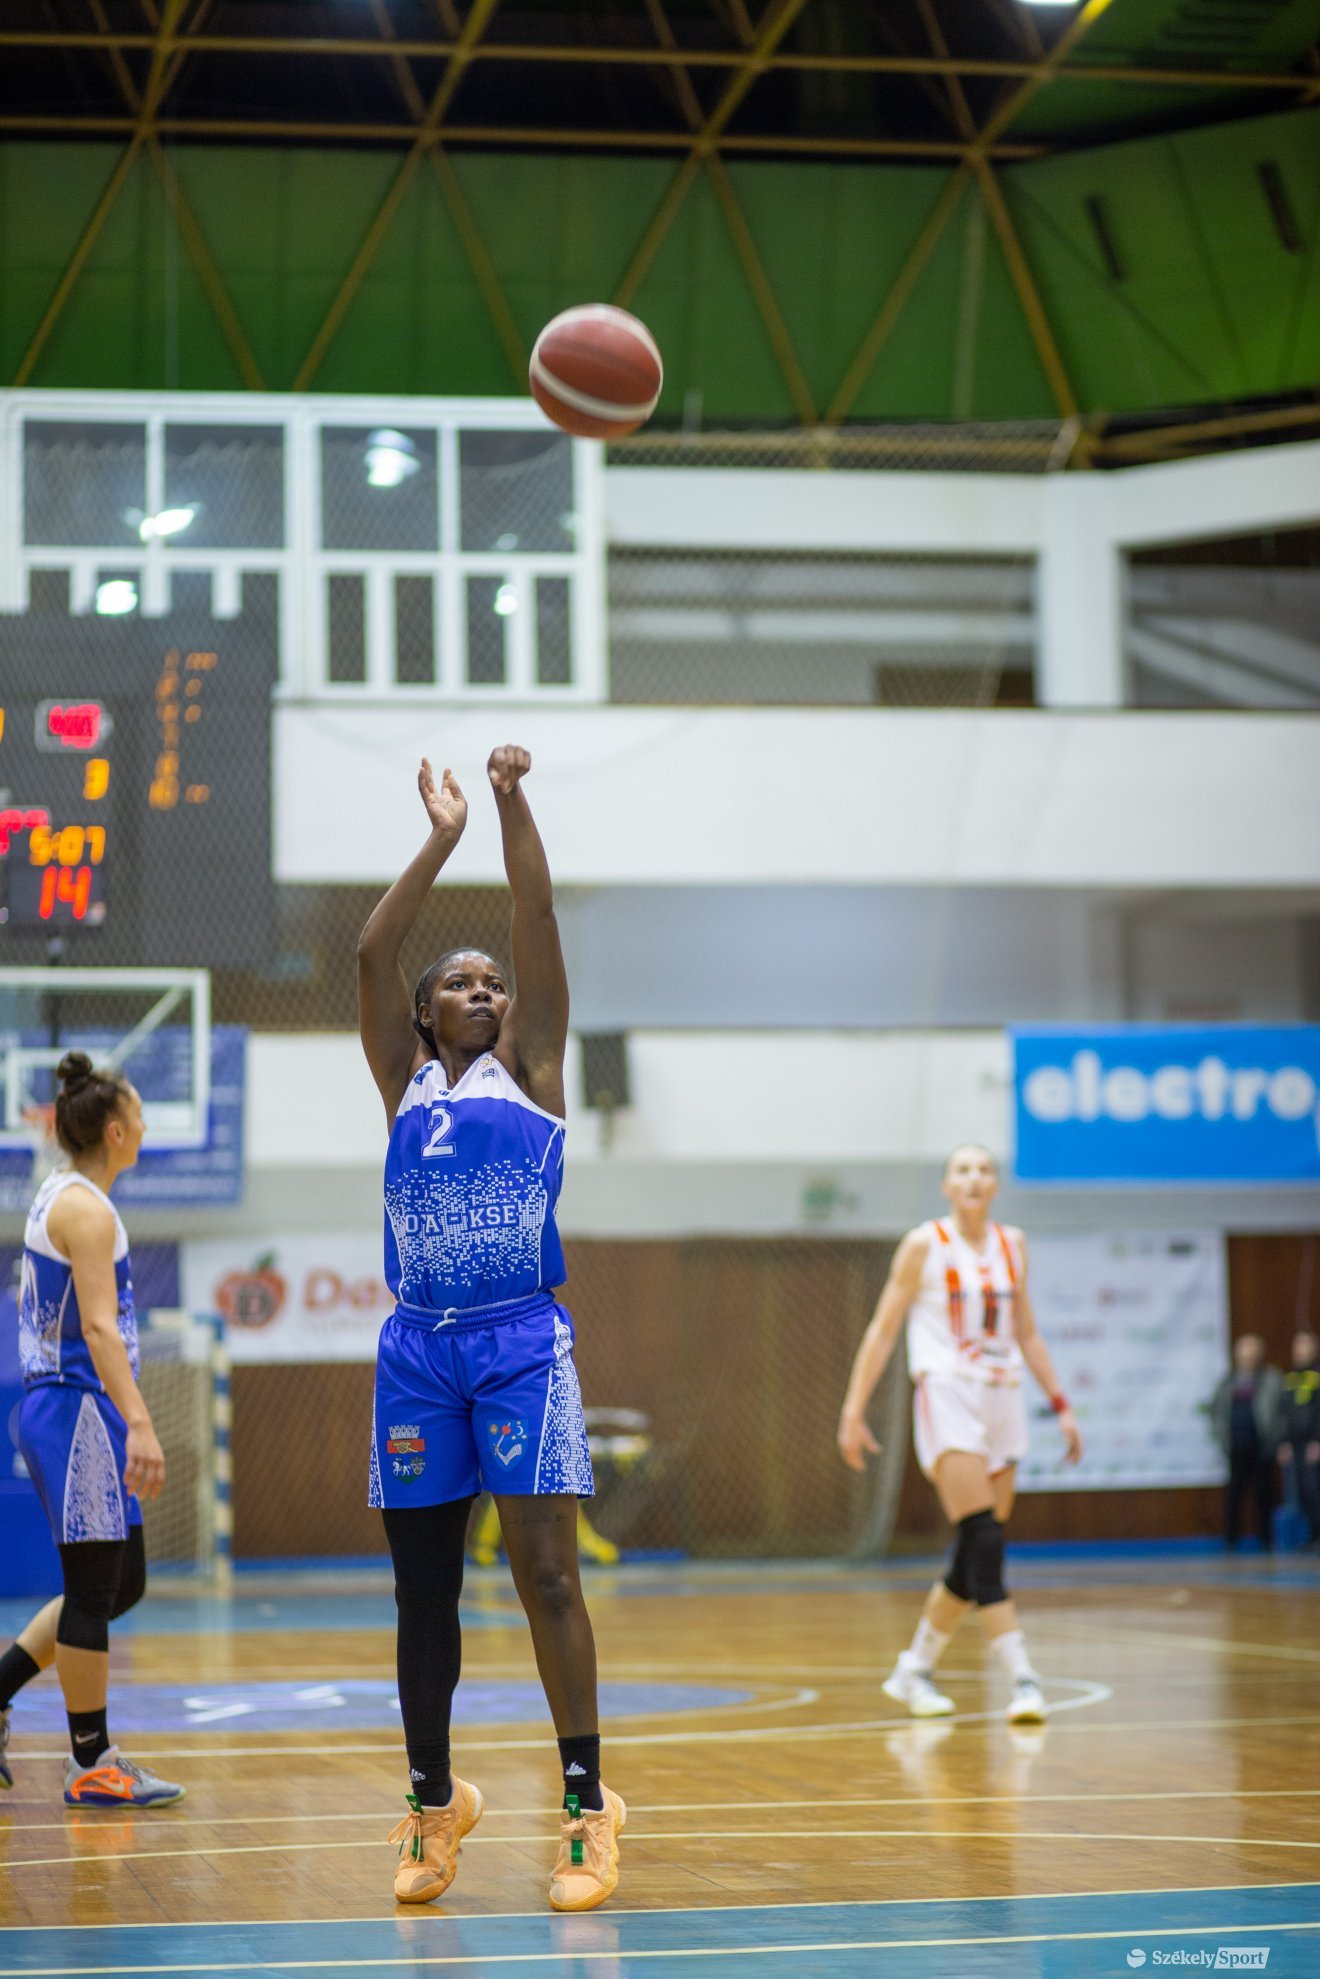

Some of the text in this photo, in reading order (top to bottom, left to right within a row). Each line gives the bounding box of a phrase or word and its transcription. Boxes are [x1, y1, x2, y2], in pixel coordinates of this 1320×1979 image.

[39, 866, 92, 919] 14
[1022, 1048, 1316, 1123] electro
[421, 1105, 456, 1160] 2
[468, 1204, 517, 1228] KSE
